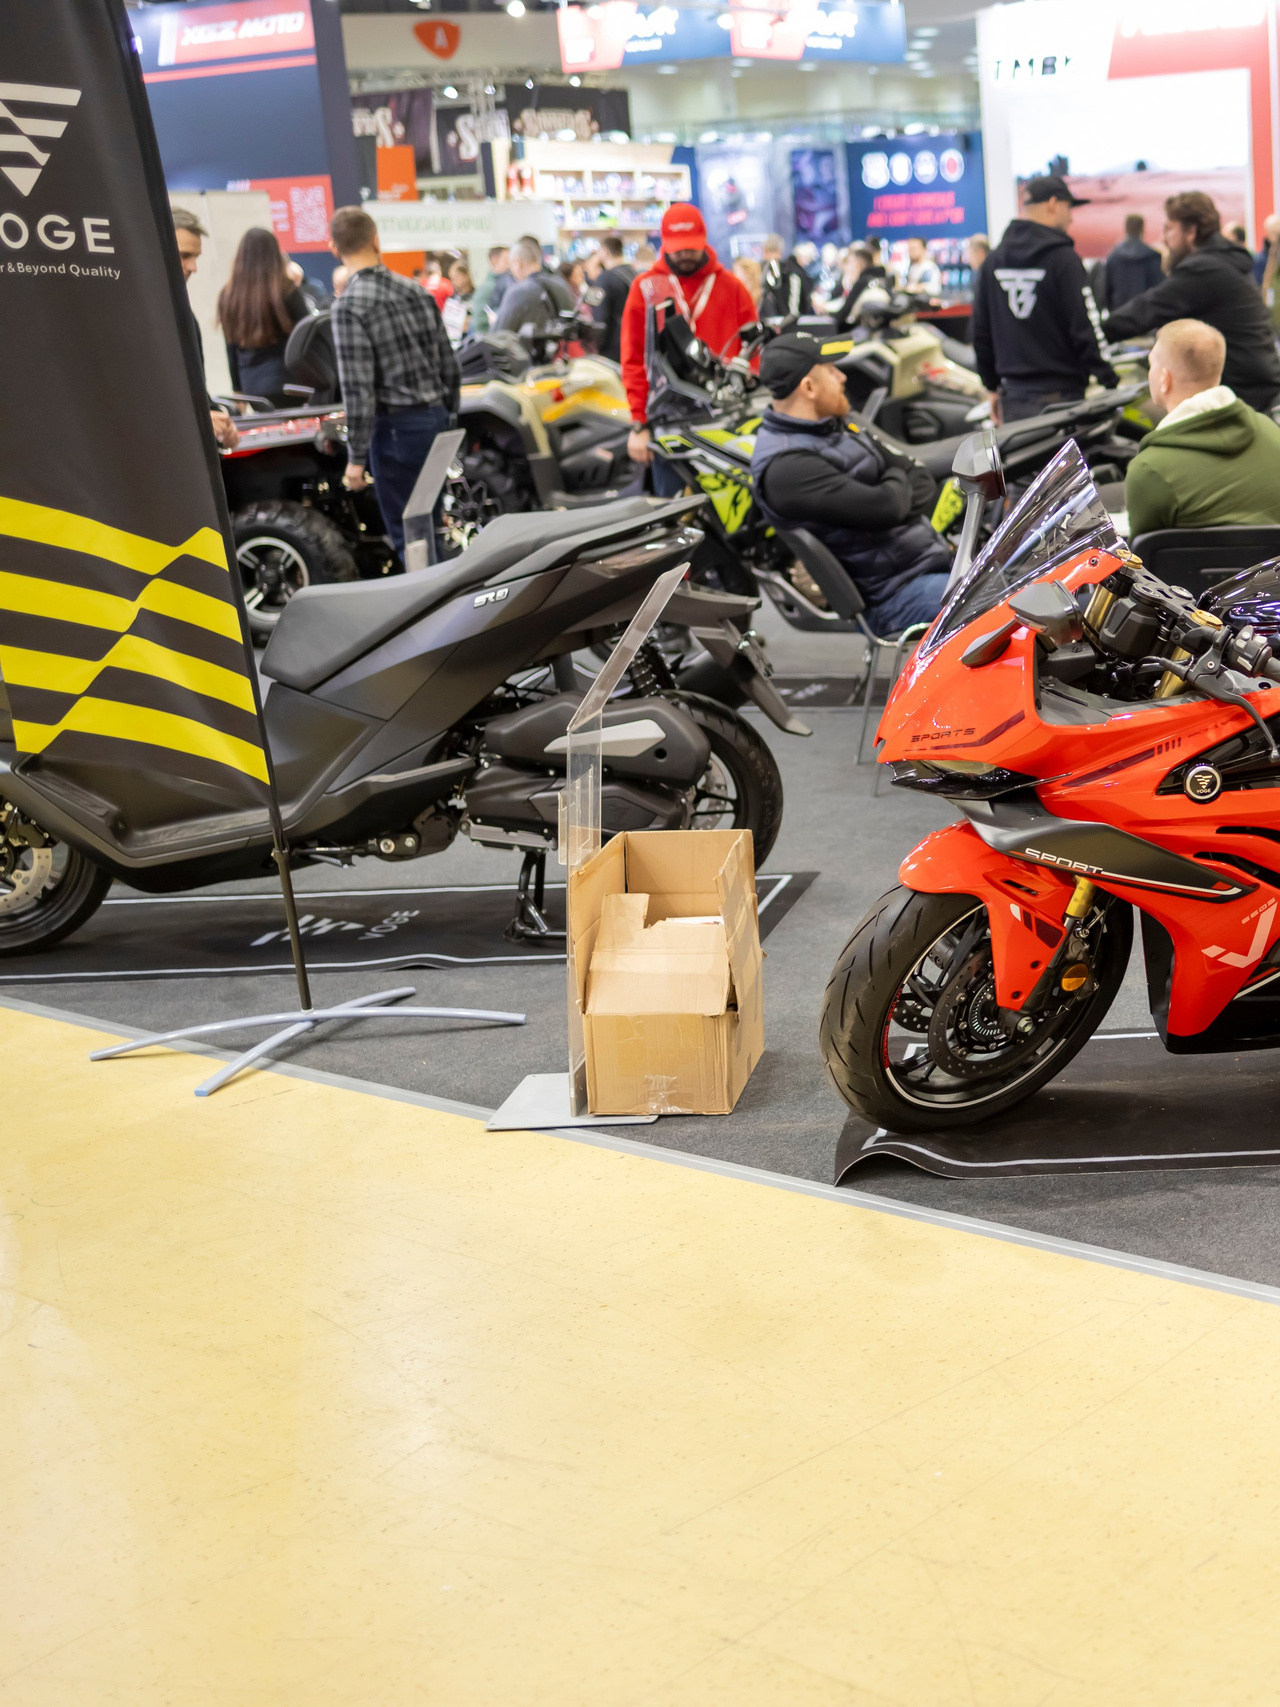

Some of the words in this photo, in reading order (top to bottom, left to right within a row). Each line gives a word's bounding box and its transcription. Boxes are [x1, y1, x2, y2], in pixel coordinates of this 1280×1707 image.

[238, 11, 305, 39] MOTO
[16, 262, 66, 275] Beyond
[69, 263, 121, 280] Quality
[911, 727, 976, 743] SPORTS
[1025, 847, 1104, 874] SPORT
[358, 909, 420, 941] VOGE
